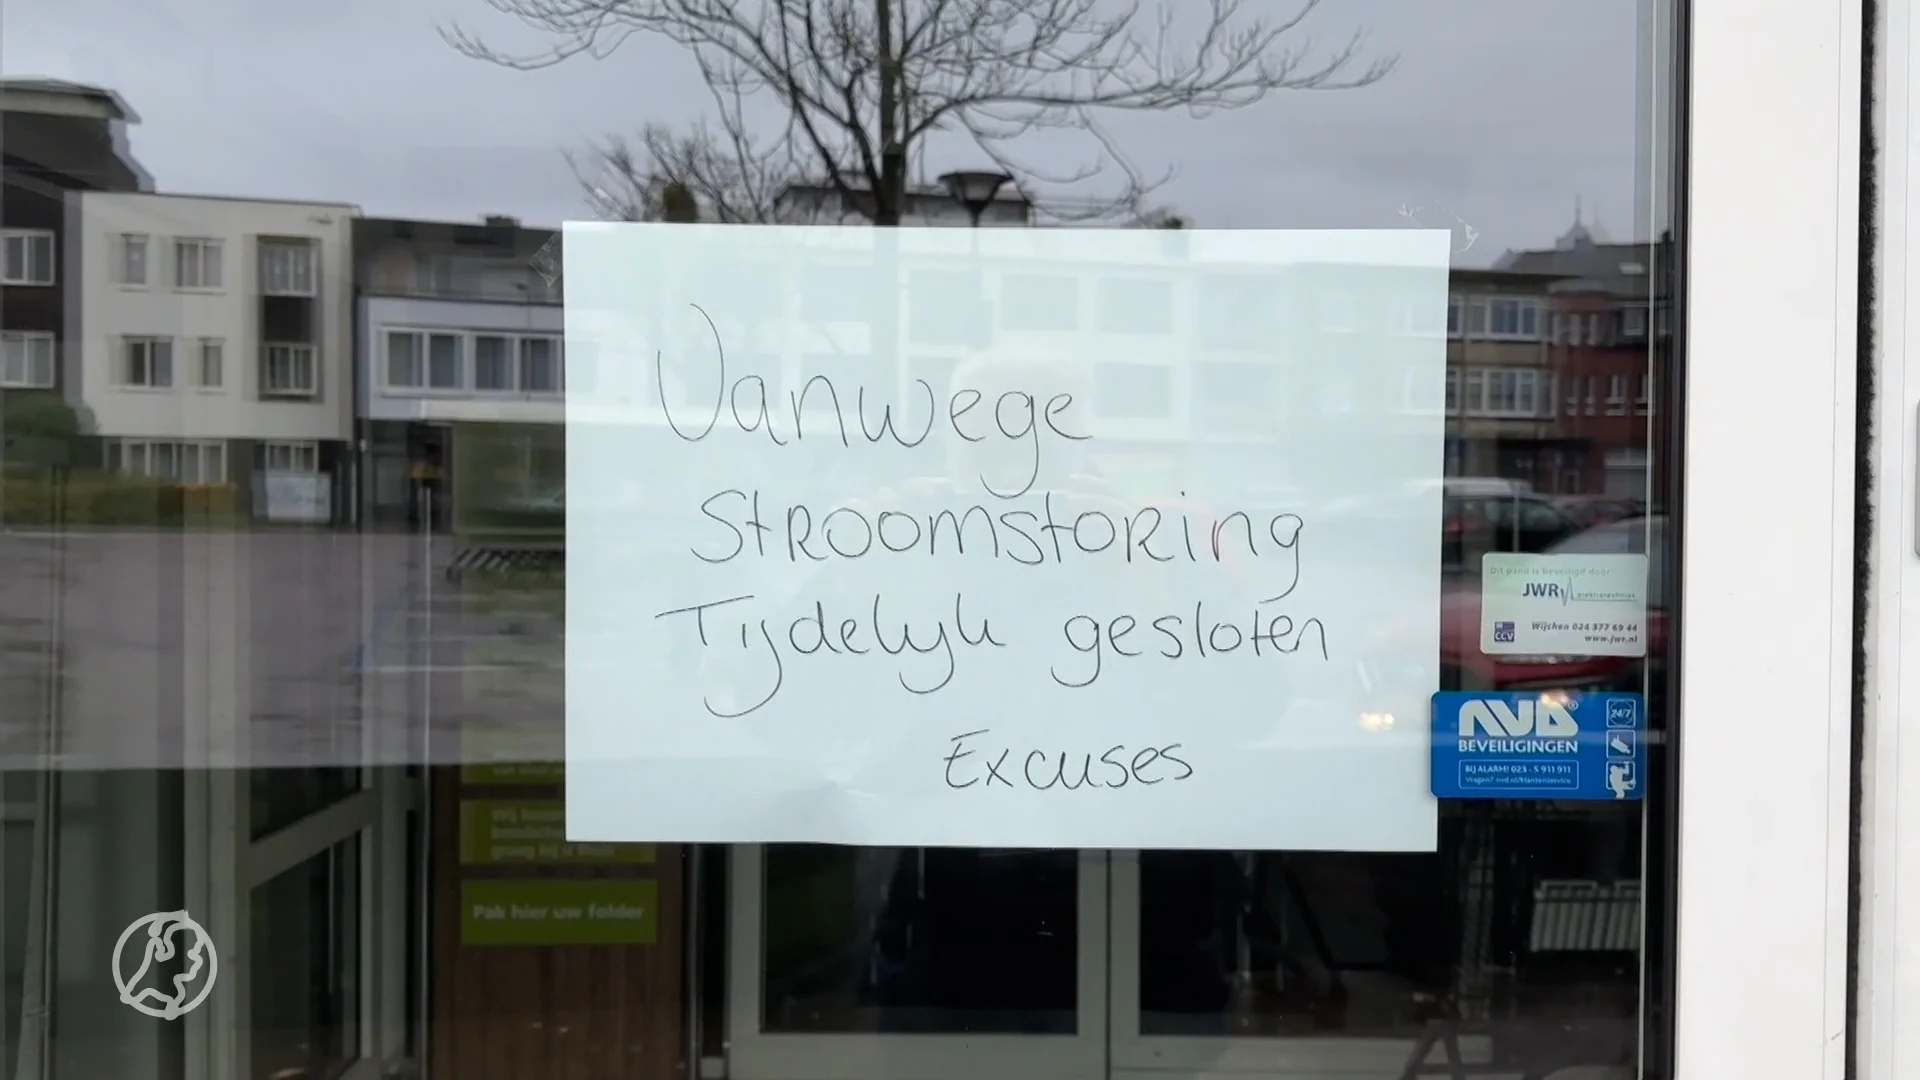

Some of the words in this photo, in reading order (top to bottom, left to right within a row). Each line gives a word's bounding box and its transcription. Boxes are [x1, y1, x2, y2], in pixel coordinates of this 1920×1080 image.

[658, 303, 1093, 499] Vanwege
[1490, 566, 1504, 575] Dit
[1506, 567, 1529, 577] pand
[1532, 567, 1540, 575] is
[1543, 567, 1585, 577] beveiligd
[1588, 567, 1611, 576] door
[1522, 583, 1559, 597] JWR
[1532, 621, 1569, 632] Wijchen
[1572, 622, 1591, 631] 024
[1592, 622, 1610, 632] 377
[1612, 623, 1625, 632] 69
[1626, 623, 1638, 632] 44
[1051, 594, 1330, 688] gesloten
[1495, 631, 1514, 641] CCV
[1585, 635, 1638, 644] www.jwr.nl
[1610, 708, 1632, 719] 24/7
[1458, 739, 1579, 753] BEVEILIGINGEN
[944, 729, 1194, 791] Excuses
[1465, 765, 1476, 774] BIJ
[1478, 765, 1509, 774] ALARM!
[1510, 765, 1527, 774] 023
[1541, 765, 1556, 774] 911
[1556, 765, 1571, 774] 911
[1465, 776, 1494, 785] Vragen?
[473, 904, 505, 919] Pak
[511, 904, 548, 919] hier
[553, 907, 583, 919] uw
[588, 903, 645, 920] folder
